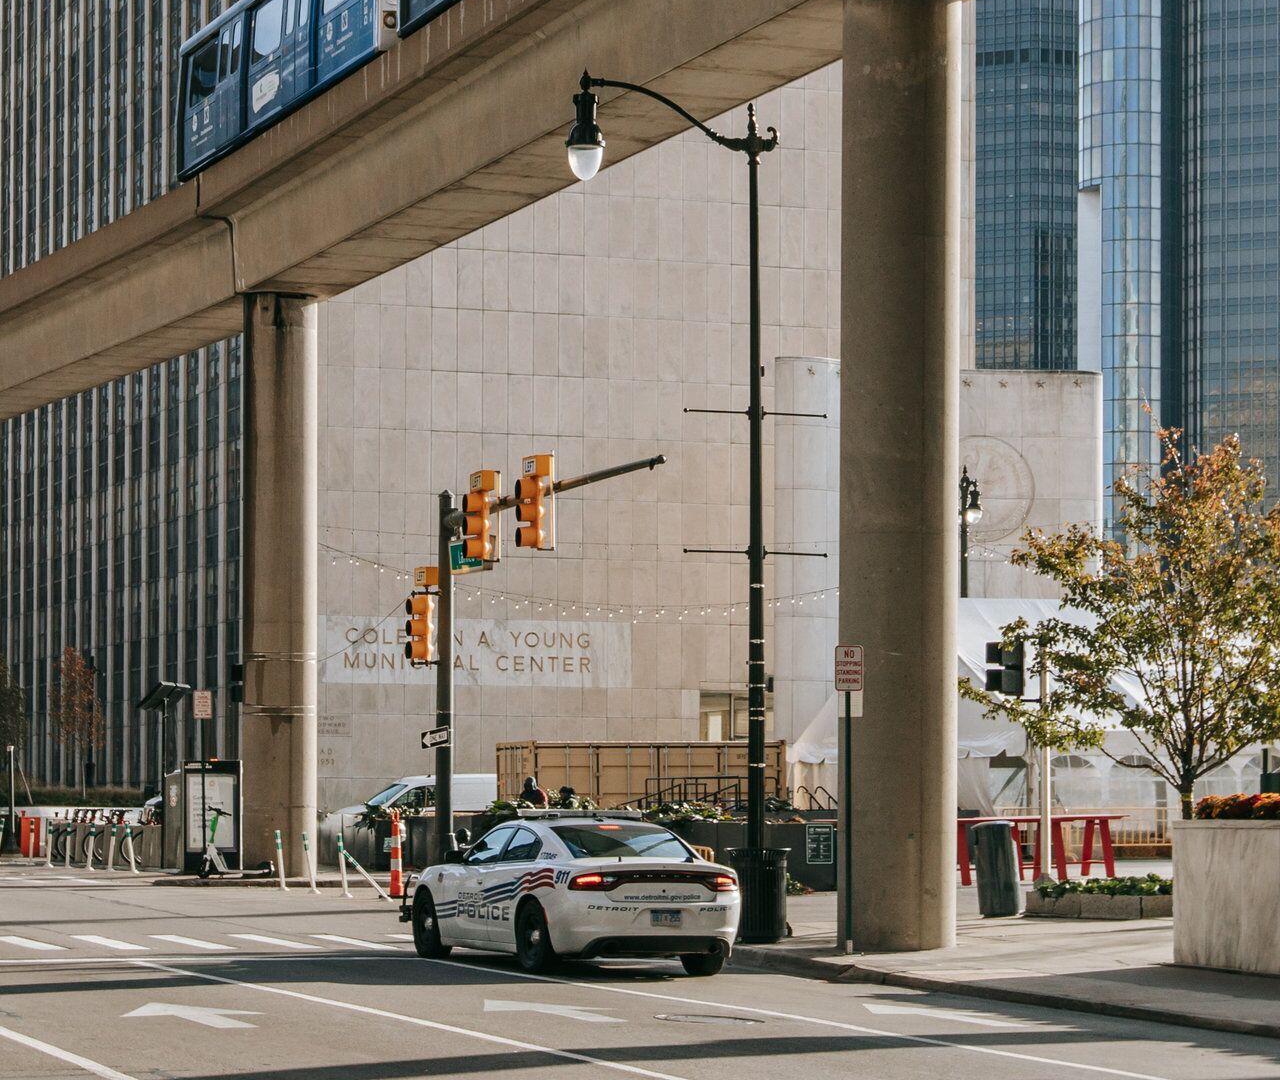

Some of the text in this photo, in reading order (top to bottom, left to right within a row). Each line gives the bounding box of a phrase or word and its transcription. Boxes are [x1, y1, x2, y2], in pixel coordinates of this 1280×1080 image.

[345, 627, 463, 647] COLEN
[510, 631, 591, 649] YOUNG
[344, 651, 592, 673] MUNIAL CENTER
[844, 649, 855, 659] NO
[554, 870, 571, 884] 911
[458, 891, 484, 900] DETROIT
[456, 902, 510, 921] POLICE
